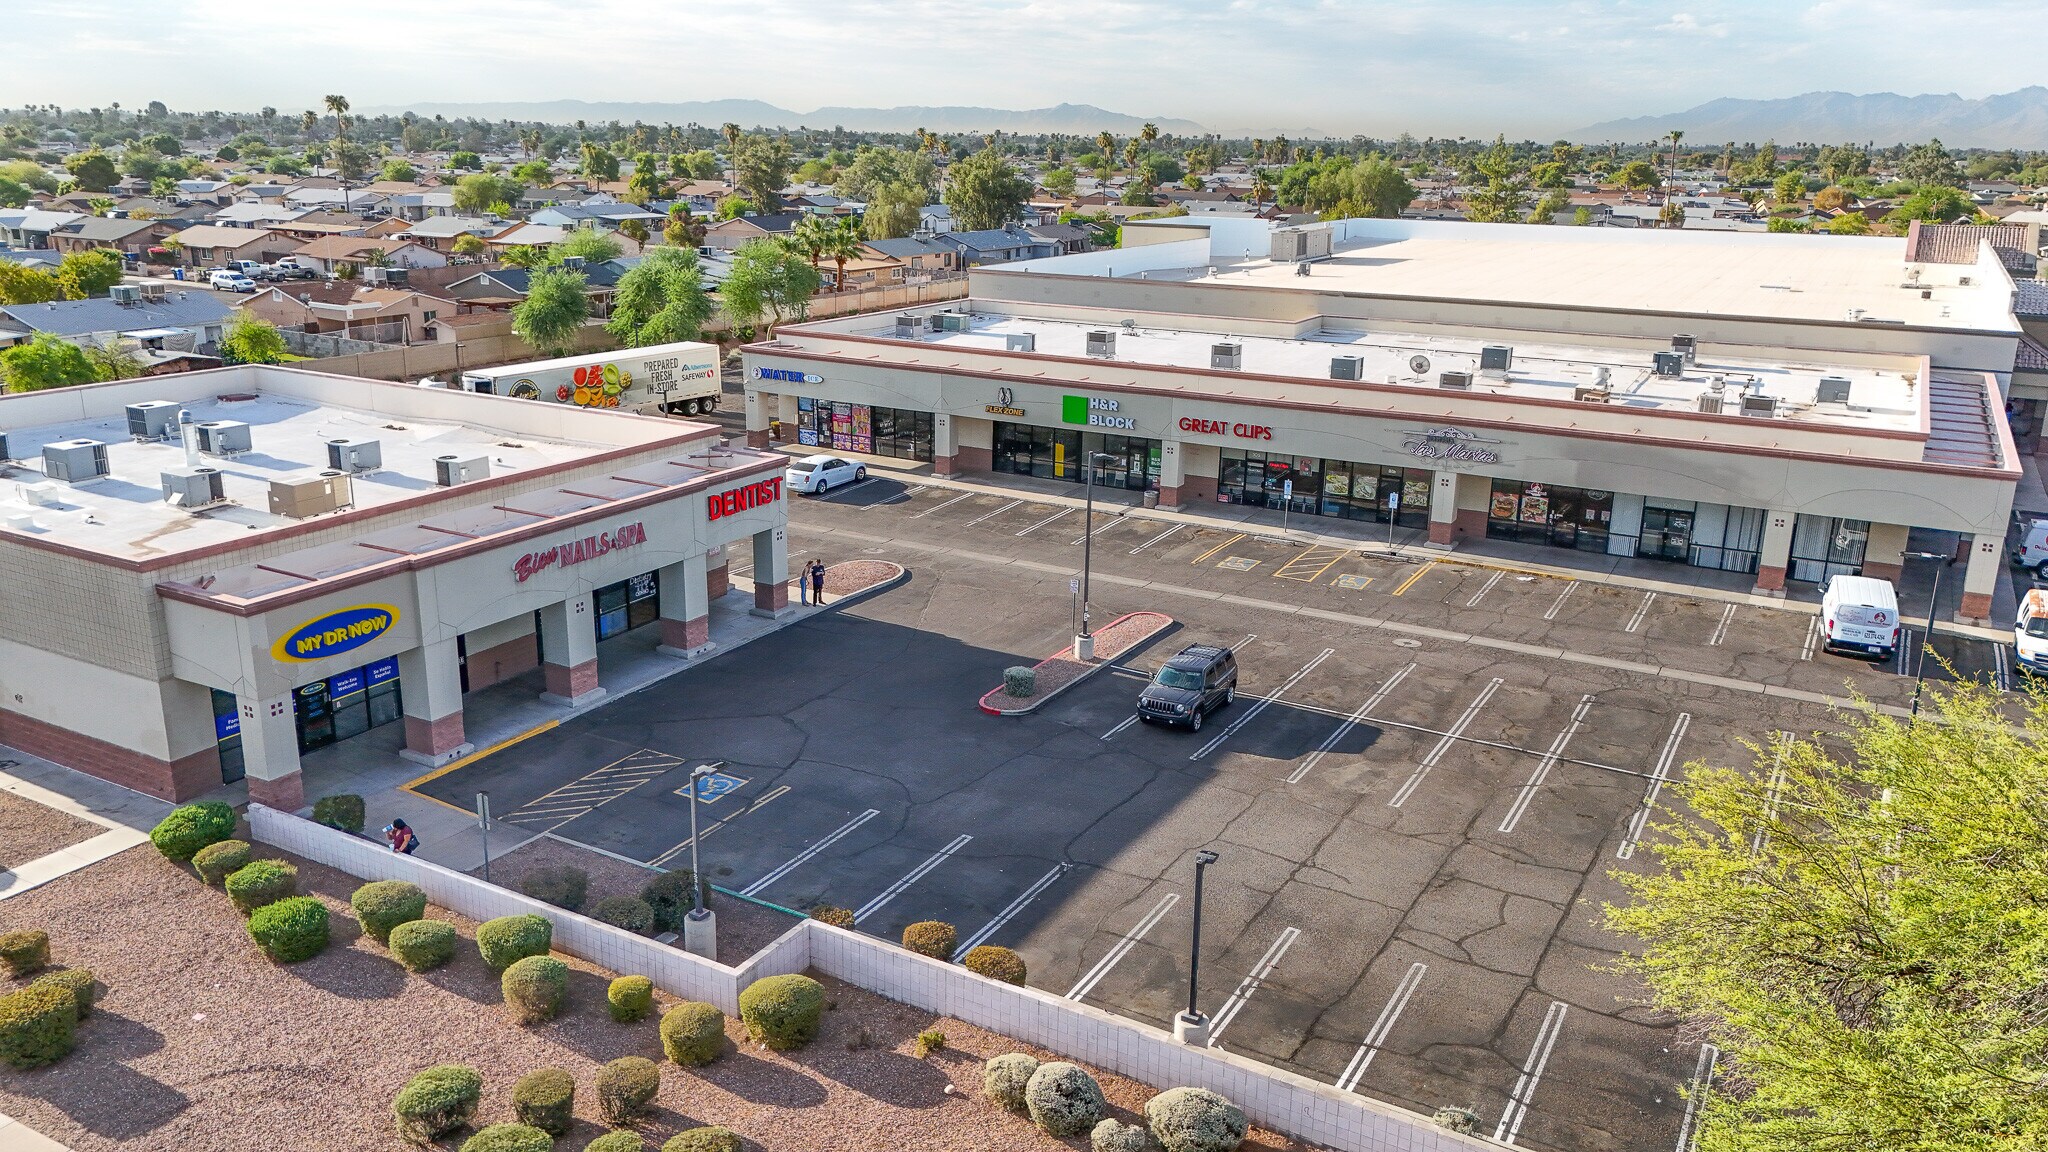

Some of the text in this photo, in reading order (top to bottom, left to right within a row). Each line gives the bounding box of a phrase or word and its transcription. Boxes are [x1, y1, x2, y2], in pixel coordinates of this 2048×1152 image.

[644, 358, 679, 372] PREPARED
[651, 370, 673, 383] FRESH
[681, 371, 707, 381] SAFEWAY
[760, 367, 805, 383] WATER
[647, 380, 679, 395] IN-STORE
[985, 405, 1025, 416] FLEX ZONE
[1089, 397, 1120, 412] H&R
[1089, 414, 1136, 430] BLOCK
[1178, 416, 1273, 441] GREAT CLIPS
[708, 476, 783, 521] DENTIST
[557, 531, 611, 568] NAILS
[614, 521, 647, 551] SPA
[296, 614, 387, 654] MY DR NOW
